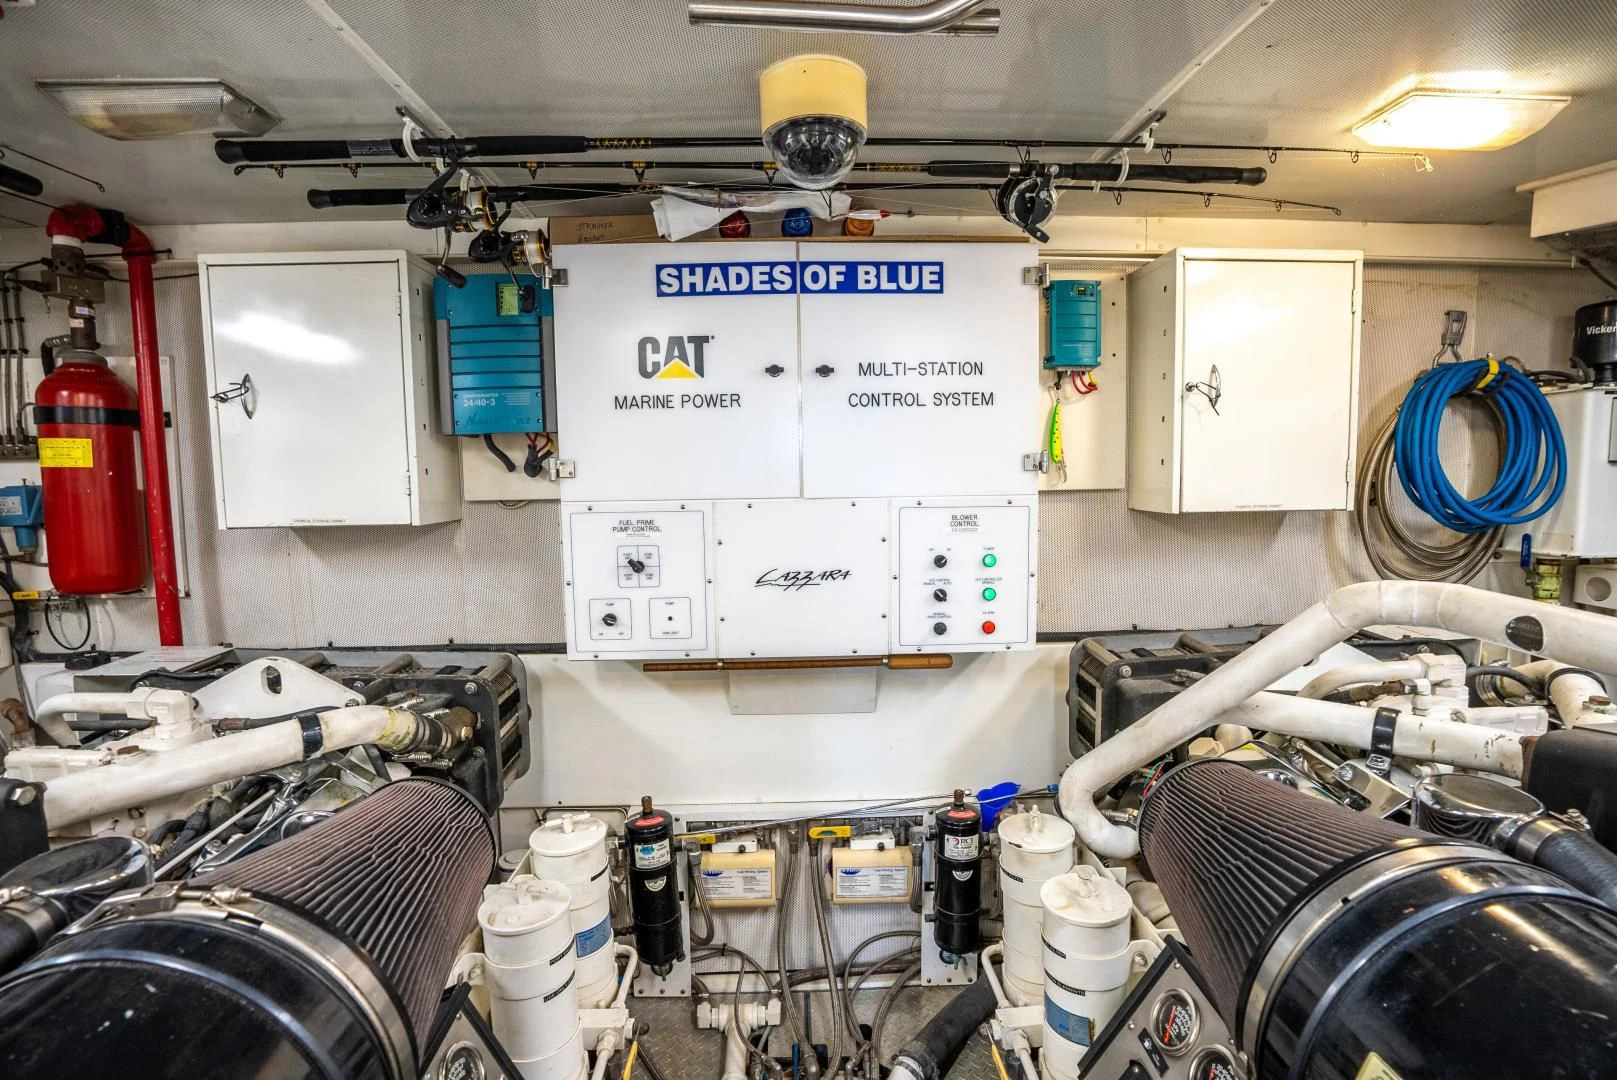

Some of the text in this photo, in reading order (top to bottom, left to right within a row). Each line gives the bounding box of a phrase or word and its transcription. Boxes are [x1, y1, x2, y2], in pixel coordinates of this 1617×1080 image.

[659, 264, 941, 293] SHADES OF BLUE
[638, 336, 710, 379] CAT
[858, 361, 984, 377] MULTI-STATION
[614, 393, 742, 410] MARINE POWER
[848, 392, 994, 408] CONTROL SYSTEM
[754, 568, 852, 591] LAZZARA
